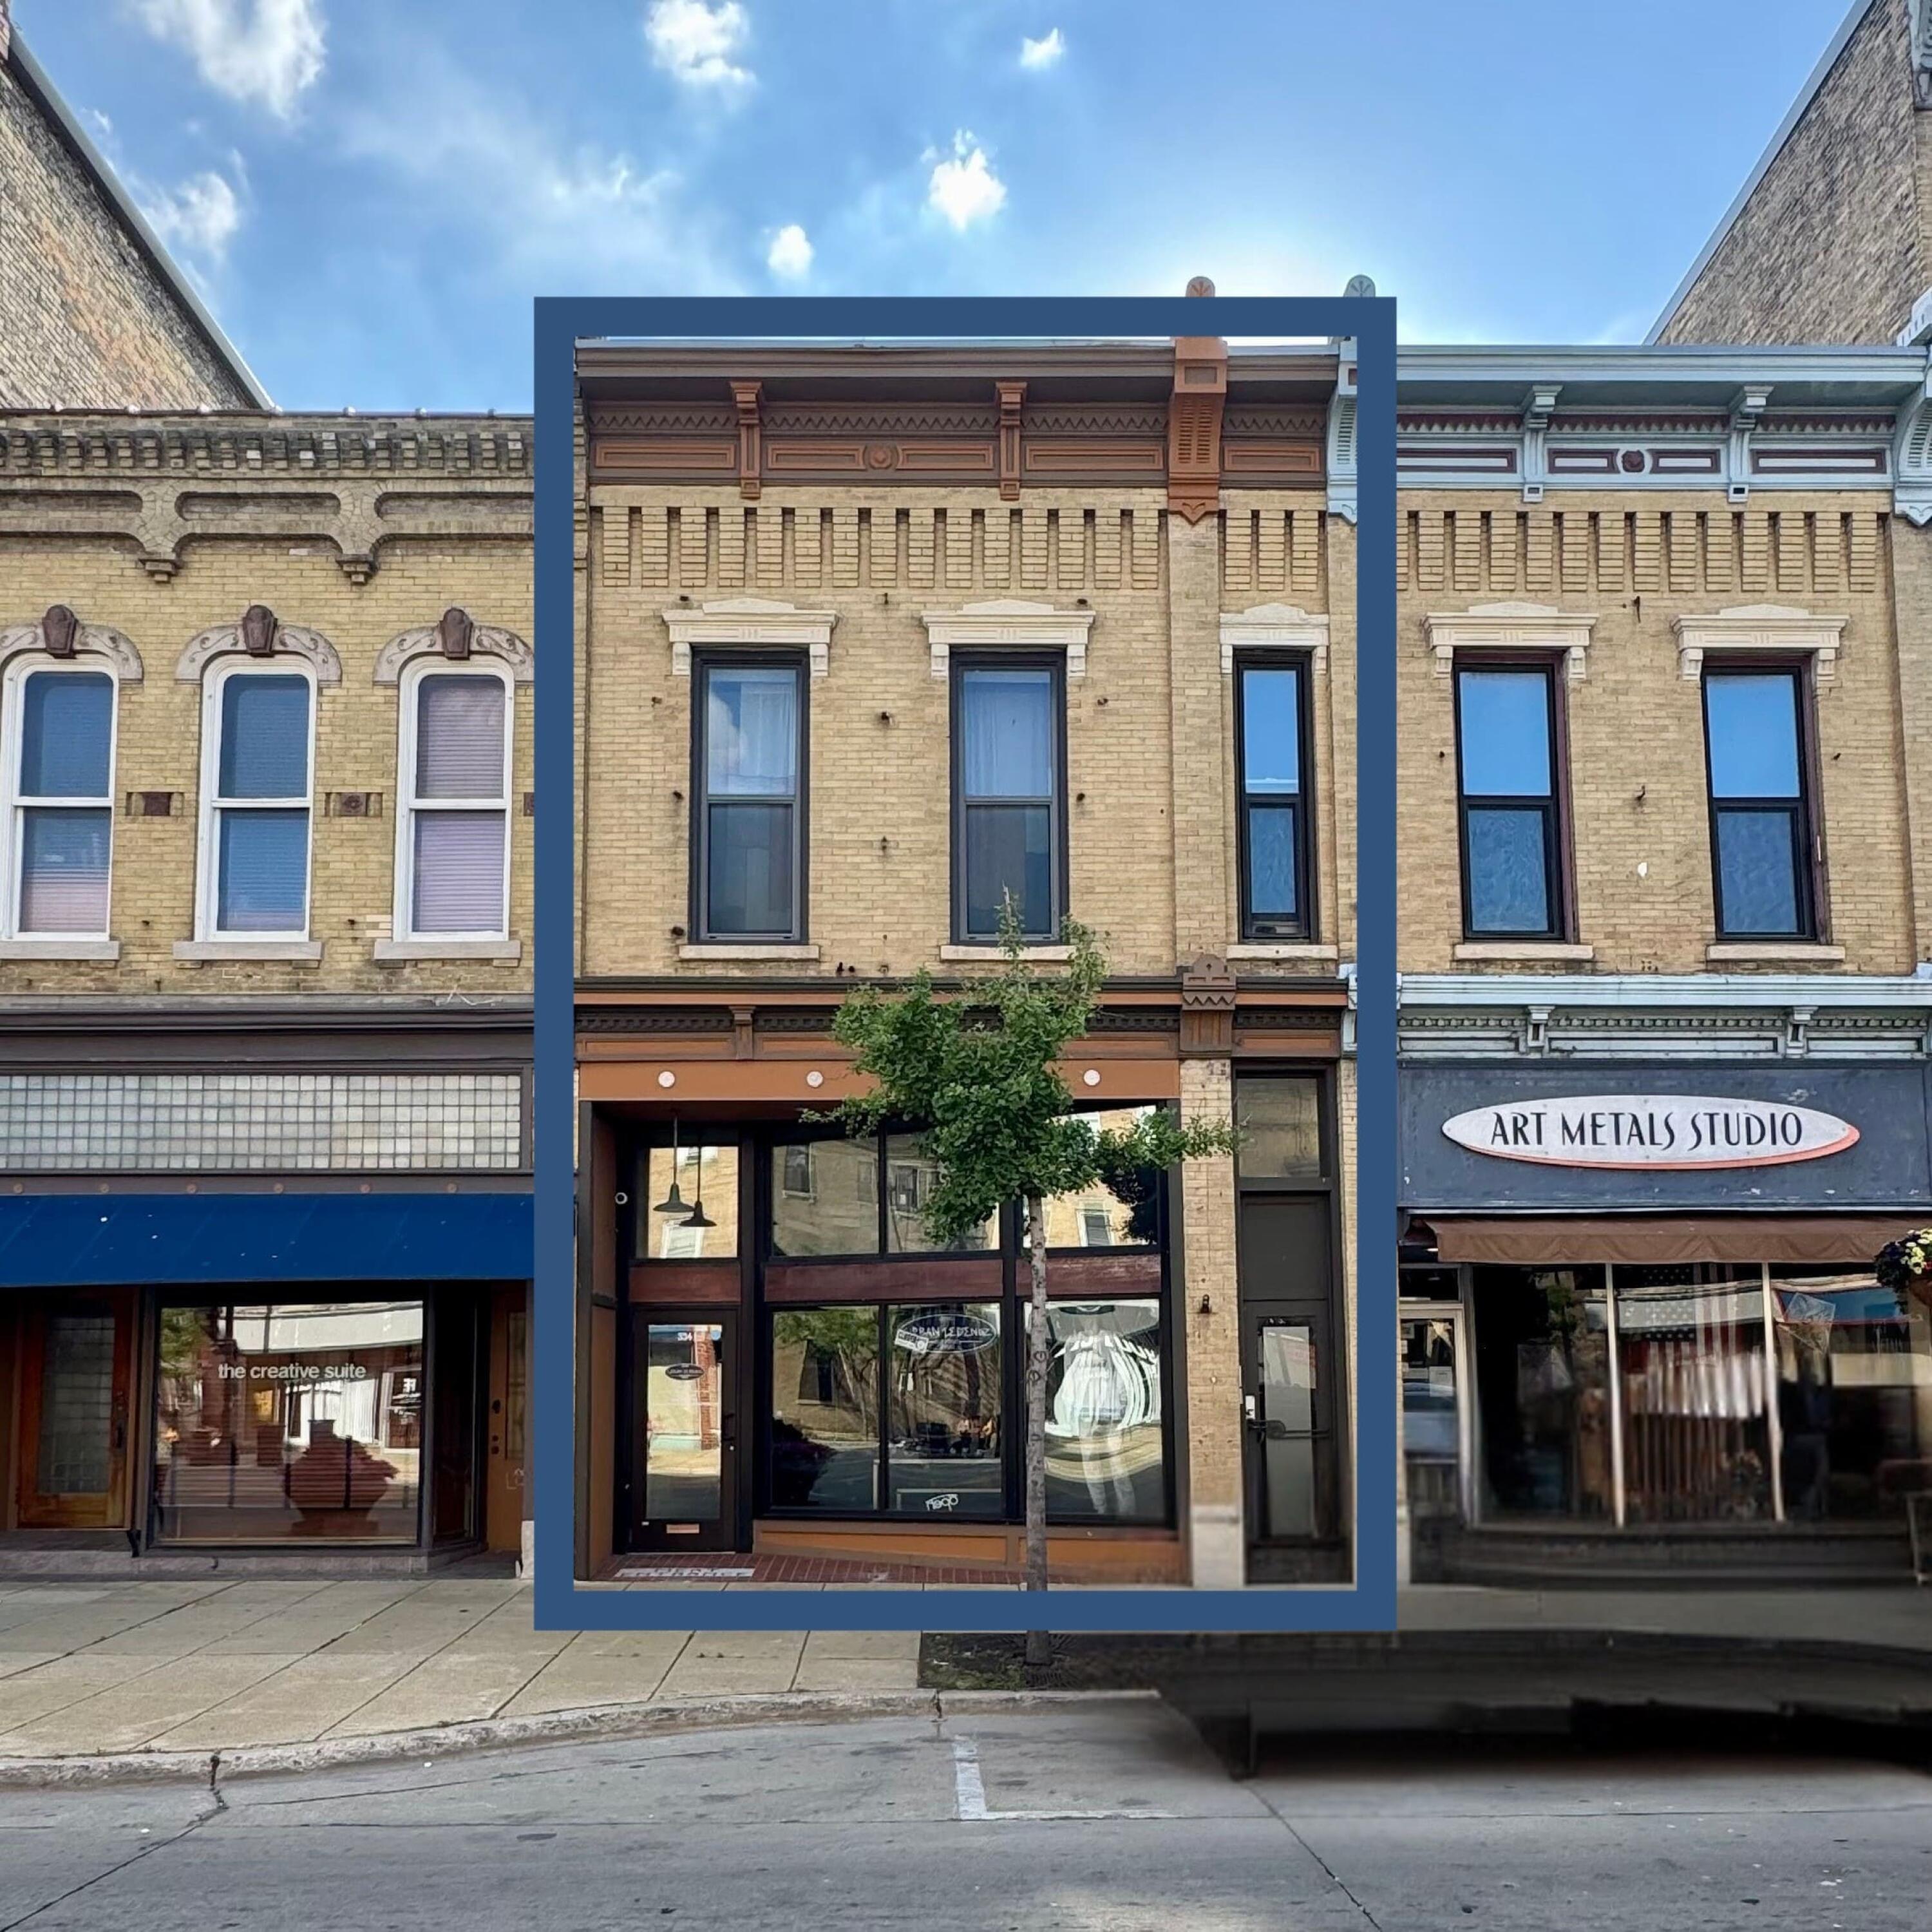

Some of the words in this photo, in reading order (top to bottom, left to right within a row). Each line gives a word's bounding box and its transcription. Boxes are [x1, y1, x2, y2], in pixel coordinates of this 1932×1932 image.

[1490, 1112, 1547, 1146] ART
[1560, 1112, 1675, 1151] METALS
[1687, 1112, 1803, 1151] STUDIO
[218, 1363, 247, 1379] the
[250, 1363, 320, 1379] creative
[324, 1363, 367, 1379] suite
